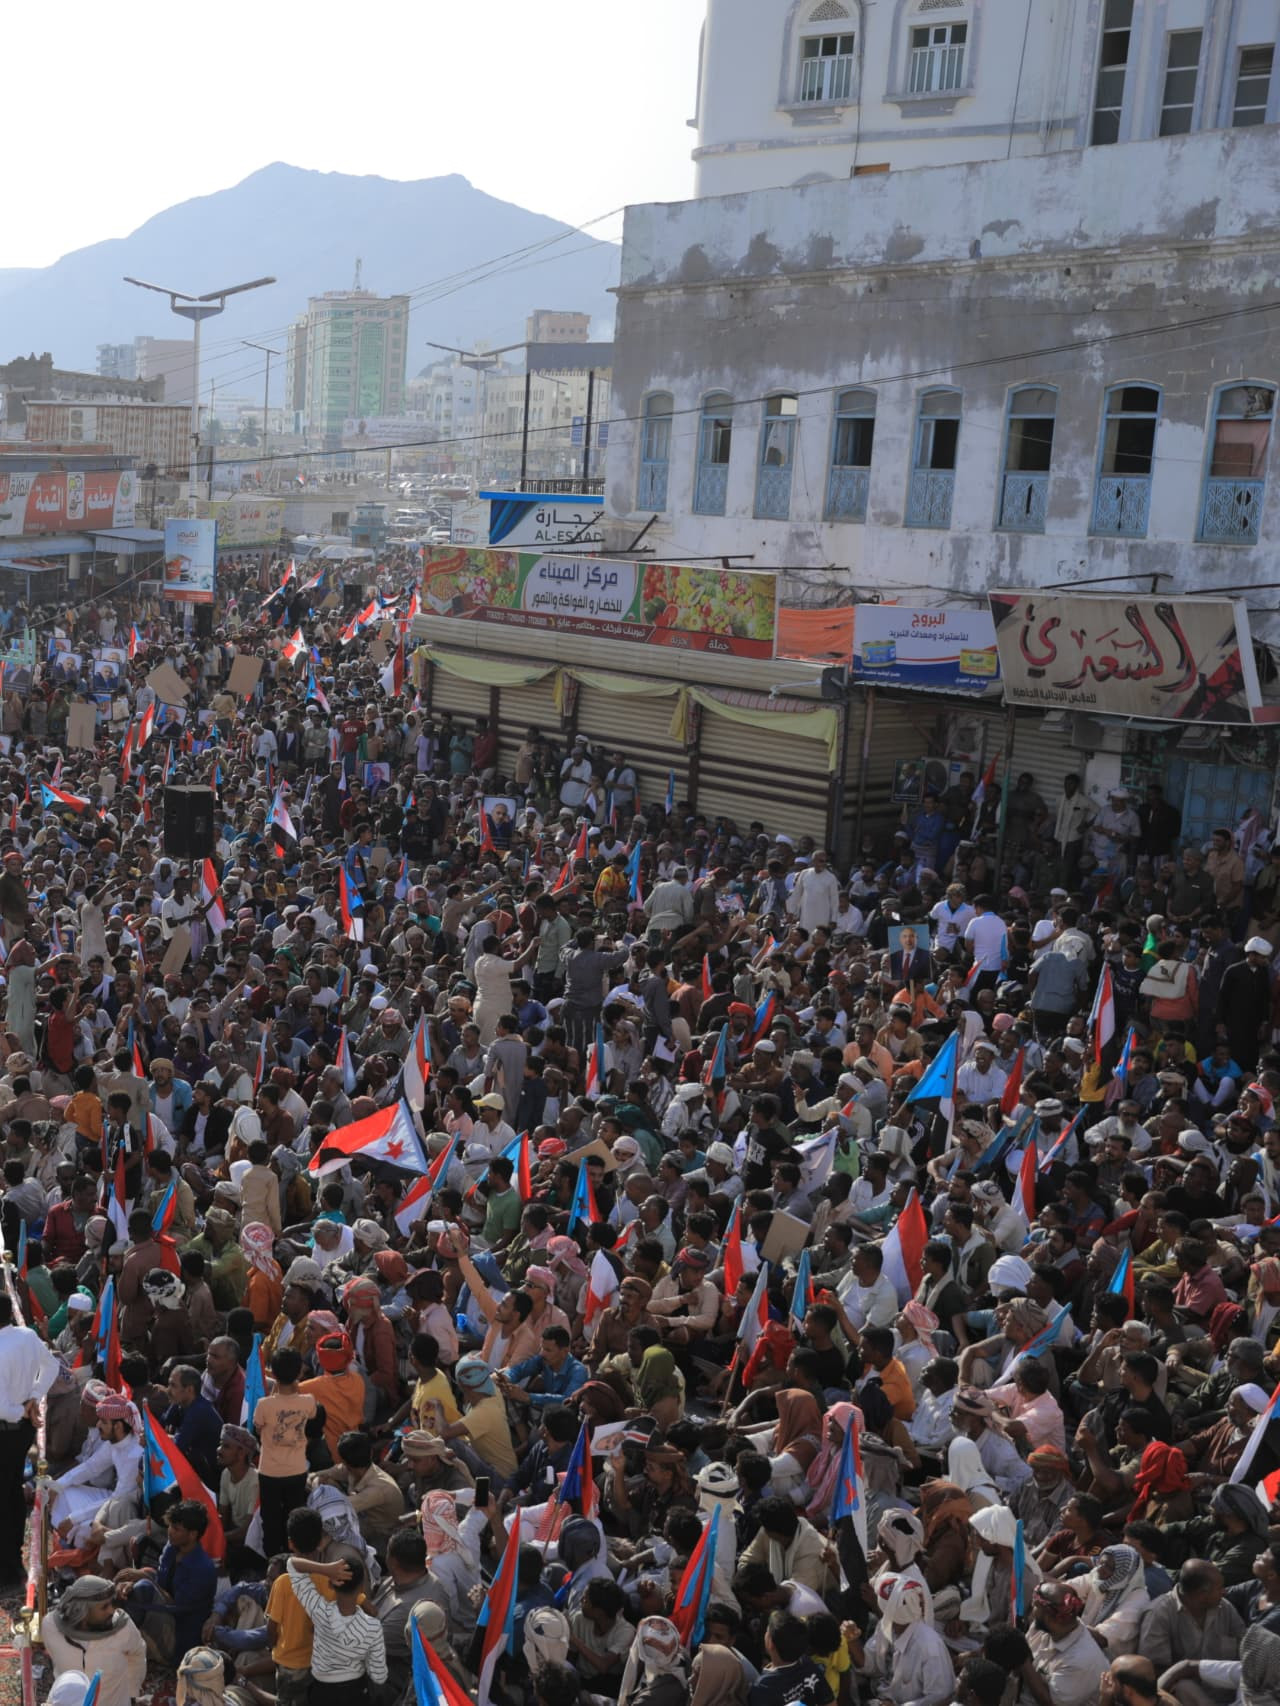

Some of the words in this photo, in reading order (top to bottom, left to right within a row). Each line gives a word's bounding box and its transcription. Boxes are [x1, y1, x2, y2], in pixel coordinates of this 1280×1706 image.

[86, 486, 114, 518] مطعم
[539, 561, 579, 584] الميناء
[583, 566, 618, 591] مركز
[594, 597, 622, 615] للخضار
[911, 612, 946, 628] البروج
[1019, 602, 1197, 693] السعدي
